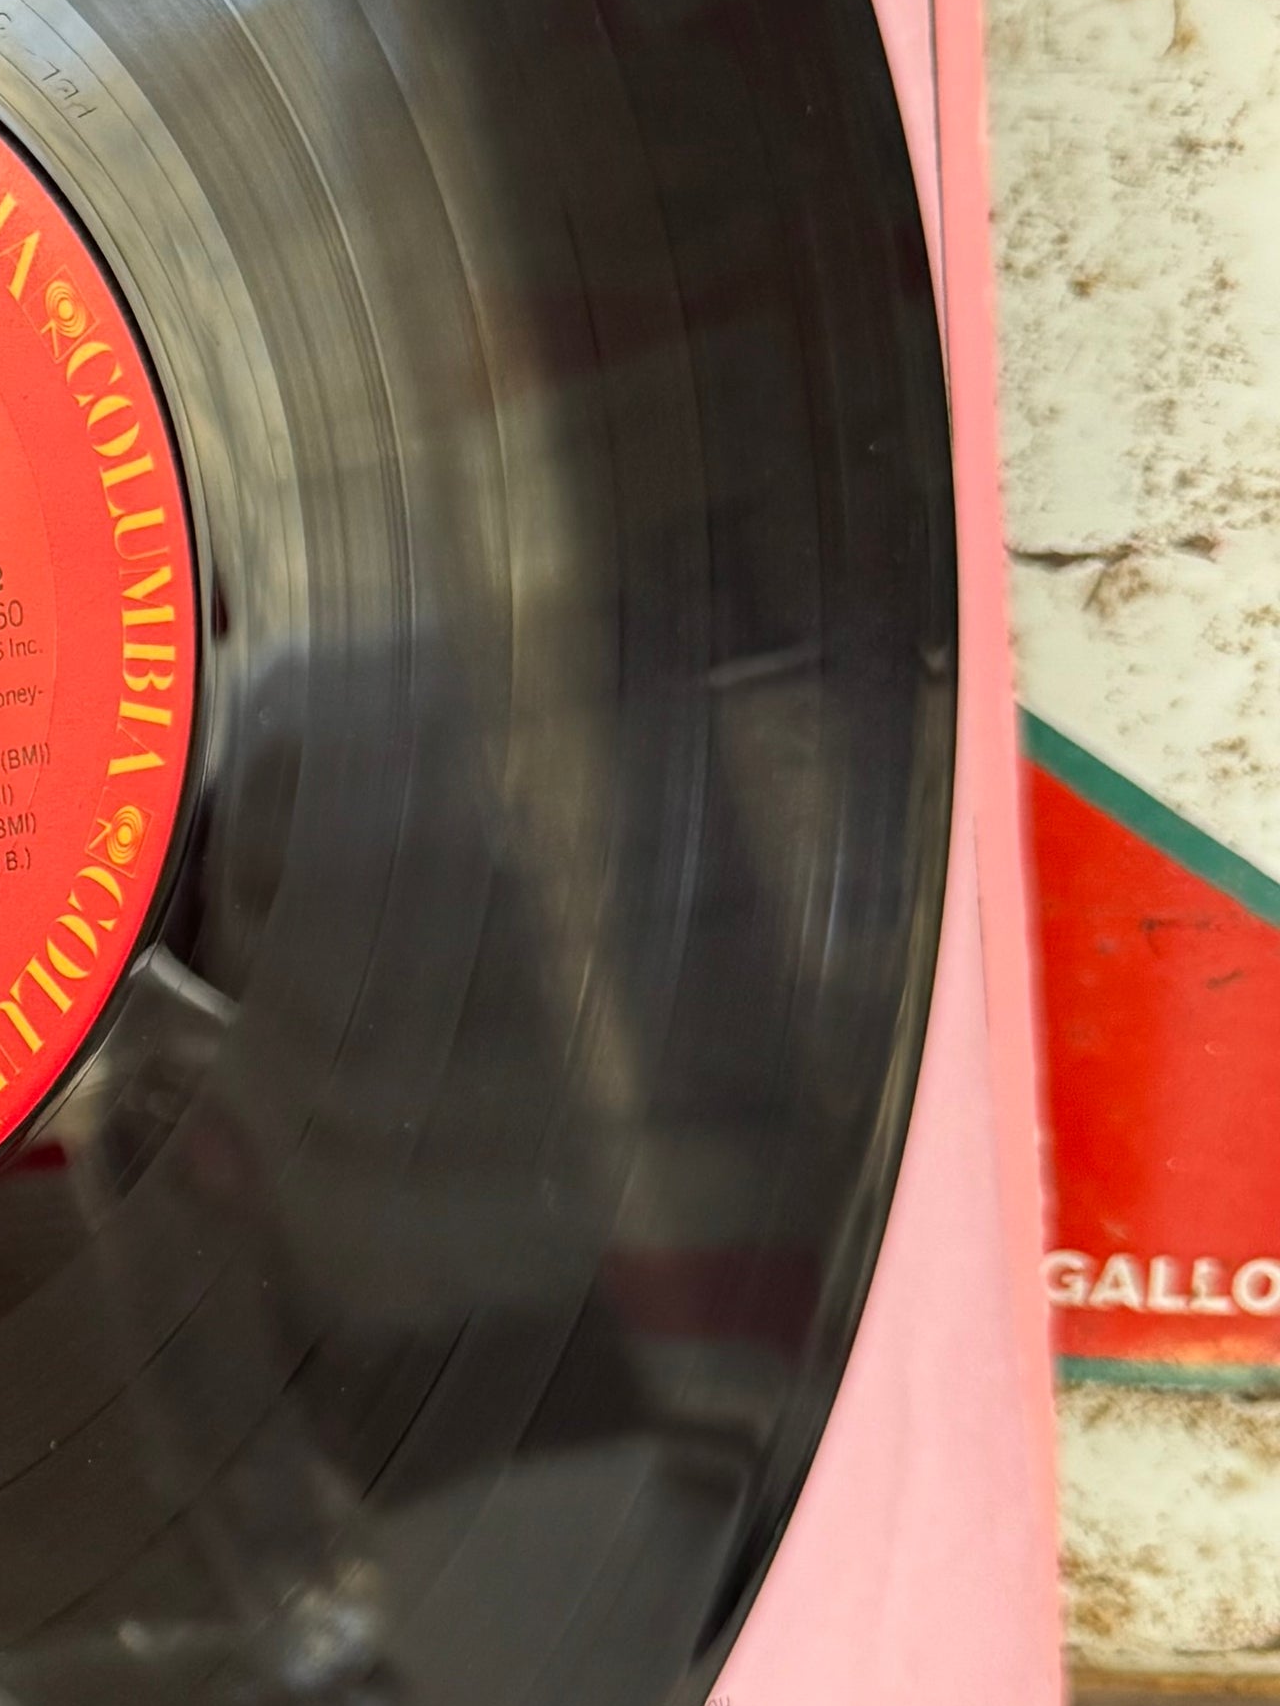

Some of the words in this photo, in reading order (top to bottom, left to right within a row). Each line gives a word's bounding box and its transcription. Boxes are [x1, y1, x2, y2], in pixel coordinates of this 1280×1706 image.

[63, 340, 176, 781] COLUMBIA
[9, 638, 43, 658] Inc.
[1040, 1249, 1280, 1317] GALLO
